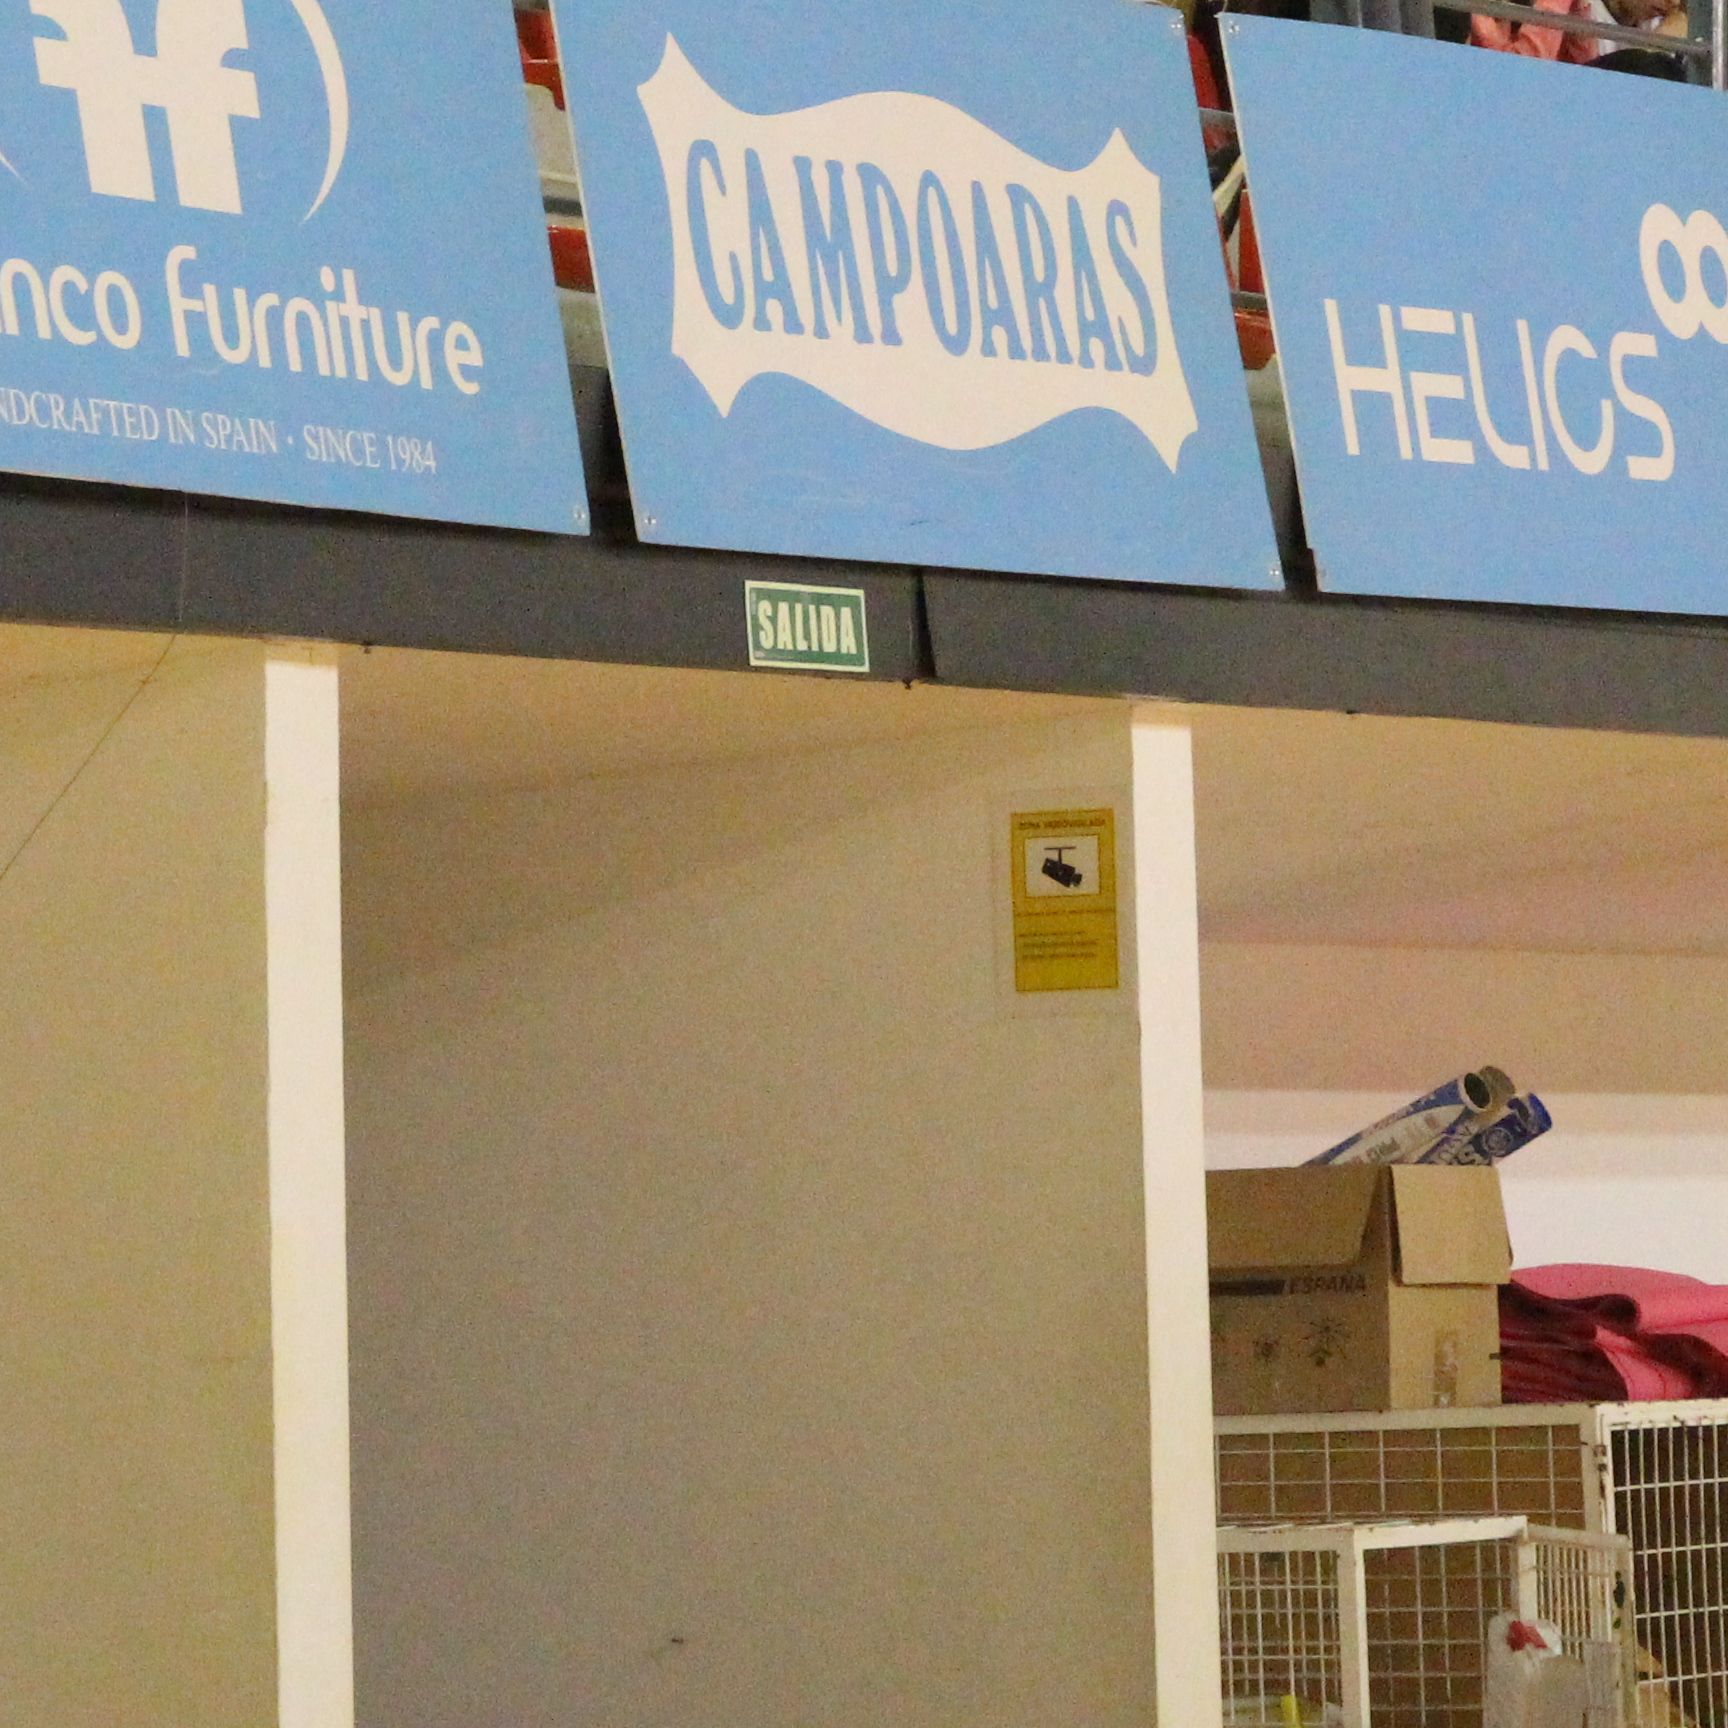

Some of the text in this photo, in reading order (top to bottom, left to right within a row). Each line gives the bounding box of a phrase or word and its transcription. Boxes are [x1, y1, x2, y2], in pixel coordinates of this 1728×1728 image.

[687, 140, 1158, 377] CAMPOARAS
[165, 407, 197, 445] IN
[203, 411, 277, 454] SPAIN
[303, 424, 380, 468] SINCE
[386, 434, 438, 474] 1984
[758, 599, 858, 655] SALIDA
